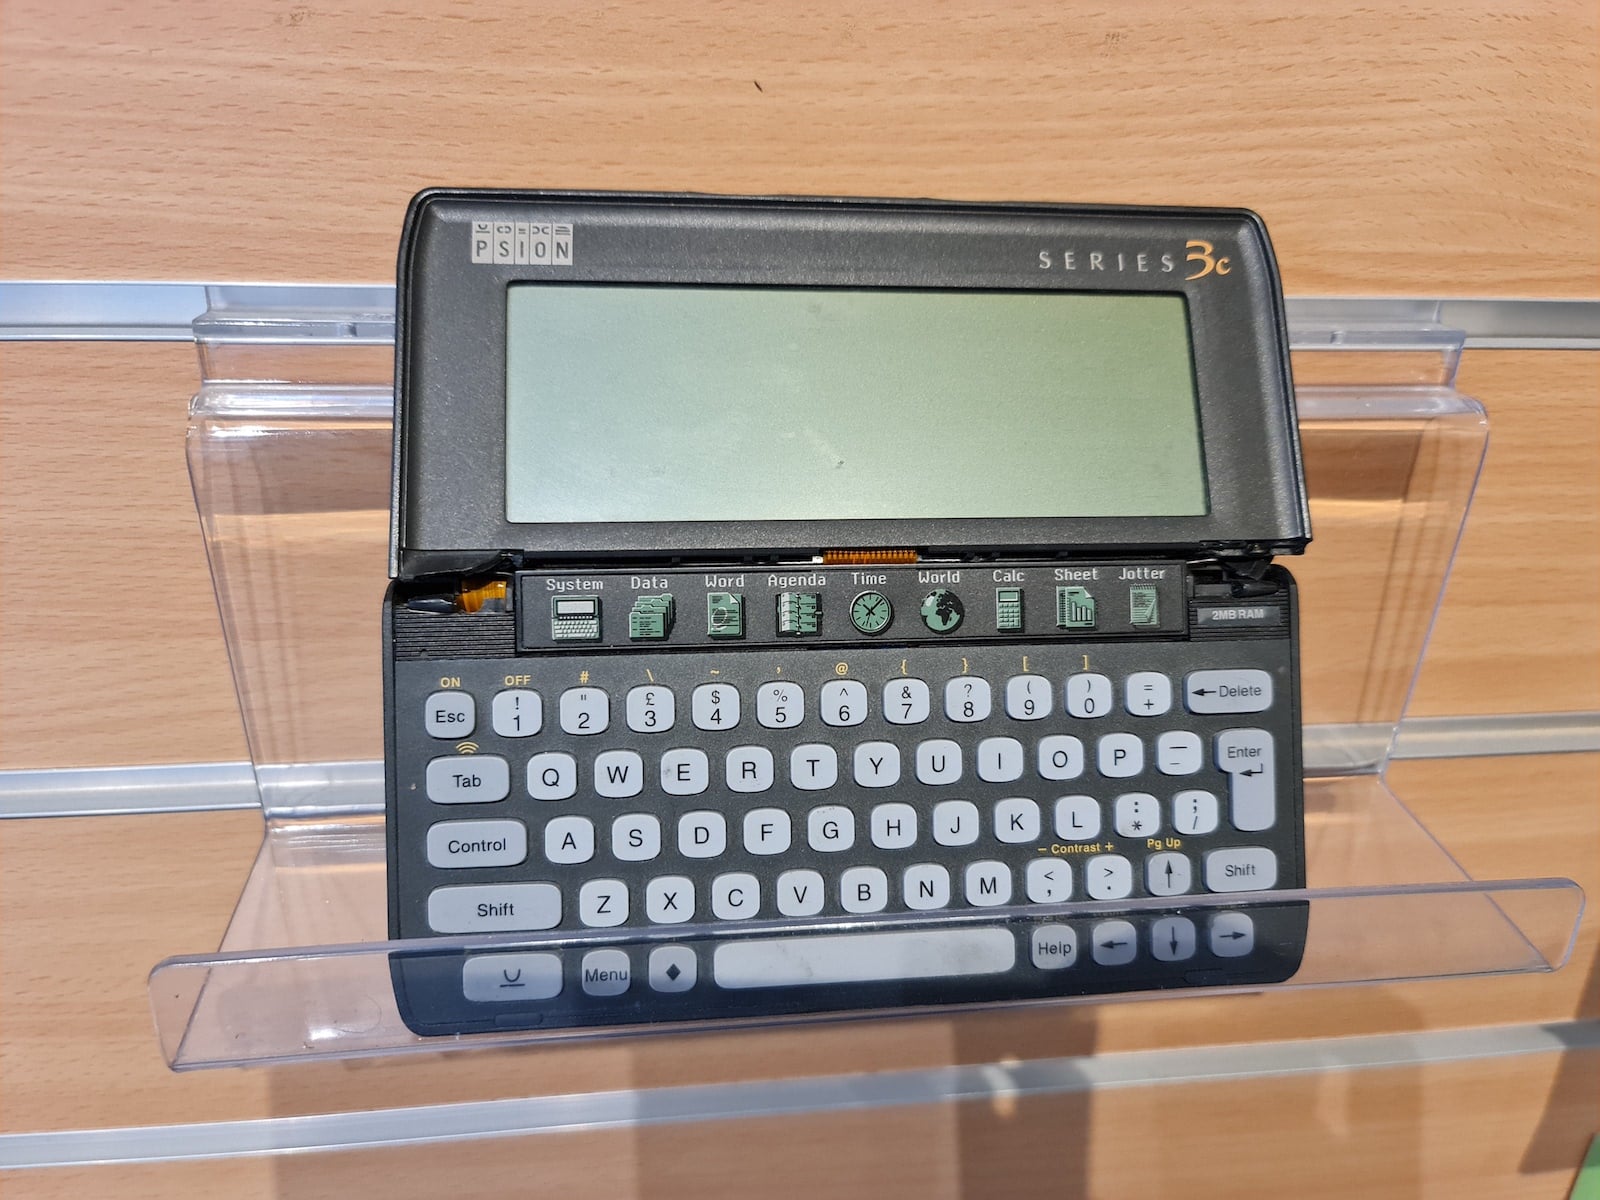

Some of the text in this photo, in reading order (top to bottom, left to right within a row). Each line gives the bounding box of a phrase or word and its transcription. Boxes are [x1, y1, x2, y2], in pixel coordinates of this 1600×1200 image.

[476, 240, 569, 259] PSION
[1039, 239, 1231, 281] SERIES 3c
[705, 574, 745, 588] Word
[767, 574, 826, 587] Agenda
[850, 572, 887, 585] Time
[918, 570, 960, 584] World
[992, 569, 1024, 583] Calc
[1054, 567, 1098, 581] Sheet
[1118, 567, 1165, 581] Jotter
[546, 578, 604, 592] System
[631, 576, 668, 589] Data
[835, 662, 849, 676] @
[901, 659, 908, 675] {
[962, 658, 969, 673] }
[1023, 656, 1029, 671] [
[1082, 655, 1089, 670] ]
[440, 677, 461, 688] ON
[504, 675, 531, 686] OFF
[580, 671, 589, 683] #
[646, 669, 654, 682] \
[839, 688, 849, 696] ^
[901, 686, 912, 699] &
[964, 684, 972, 697] ?
[1027, 680, 1031, 694] (
[1087, 679, 1091, 693] )
[1219, 685, 1262, 697] Delete
[645, 692, 655, 705] £
[711, 690, 721, 704] $
[773, 689, 788, 702] %
[515, 697, 520, 710] !
[901, 703, 912, 719] 7
[963, 701, 974, 718] 8
[1024, 699, 1035, 716] 9
[1084, 698, 1095, 714] 0
[1143, 699, 1154, 710] +
[435, 710, 465, 723] Esc
[578, 712, 590, 729] 2
[644, 710, 656, 727] 3
[710, 708, 722, 725] 4
[775, 707, 786, 723] 5
[839, 705, 850, 721] 6
[513, 715, 521, 731] 1
[1052, 750, 1068, 768] O
[1114, 749, 1127, 767] P
[1227, 746, 1262, 759] Enter
[742, 762, 757, 779] R
[806, 760, 820, 777] T
[869, 757, 883, 775] Y
[932, 755, 945, 773] U
[542, 768, 560, 787] Q
[607, 766, 629, 784] W
[677, 763, 691, 781] E
[452, 774, 482, 788] Tab
[1134, 801, 1139, 813] :
[1192, 798, 1198, 813] ;
[950, 816, 961, 834] J
[1011, 813, 1025, 831] K
[1072, 811, 1084, 829] L
[1192, 816, 1198, 830] /
[694, 826, 710, 845] D
[761, 823, 773, 842] F
[822, 821, 840, 839] G
[886, 819, 901, 837] H
[448, 838, 507, 854] Control
[561, 832, 577, 850] A
[628, 829, 643, 848] S
[1147, 837, 1181, 851] Pg Up
[1051, 842, 1101, 854] Contrast
[1104, 841, 1115, 851] +
[1043, 870, 1054, 881] <
[1103, 867, 1114, 878] >
[1224, 863, 1256, 877] Shift
[857, 884, 871, 901] B
[919, 880, 934, 898] N
[980, 877, 997, 895] M
[1047, 888, 1052, 897] ,
[663, 892, 678, 911] X
[728, 888, 744, 907] C
[793, 885, 808, 904] V
[477, 903, 514, 918] Shift
[597, 895, 611, 914] Z
[1038, 941, 1072, 957] Help
[585, 967, 628, 983] Menu
